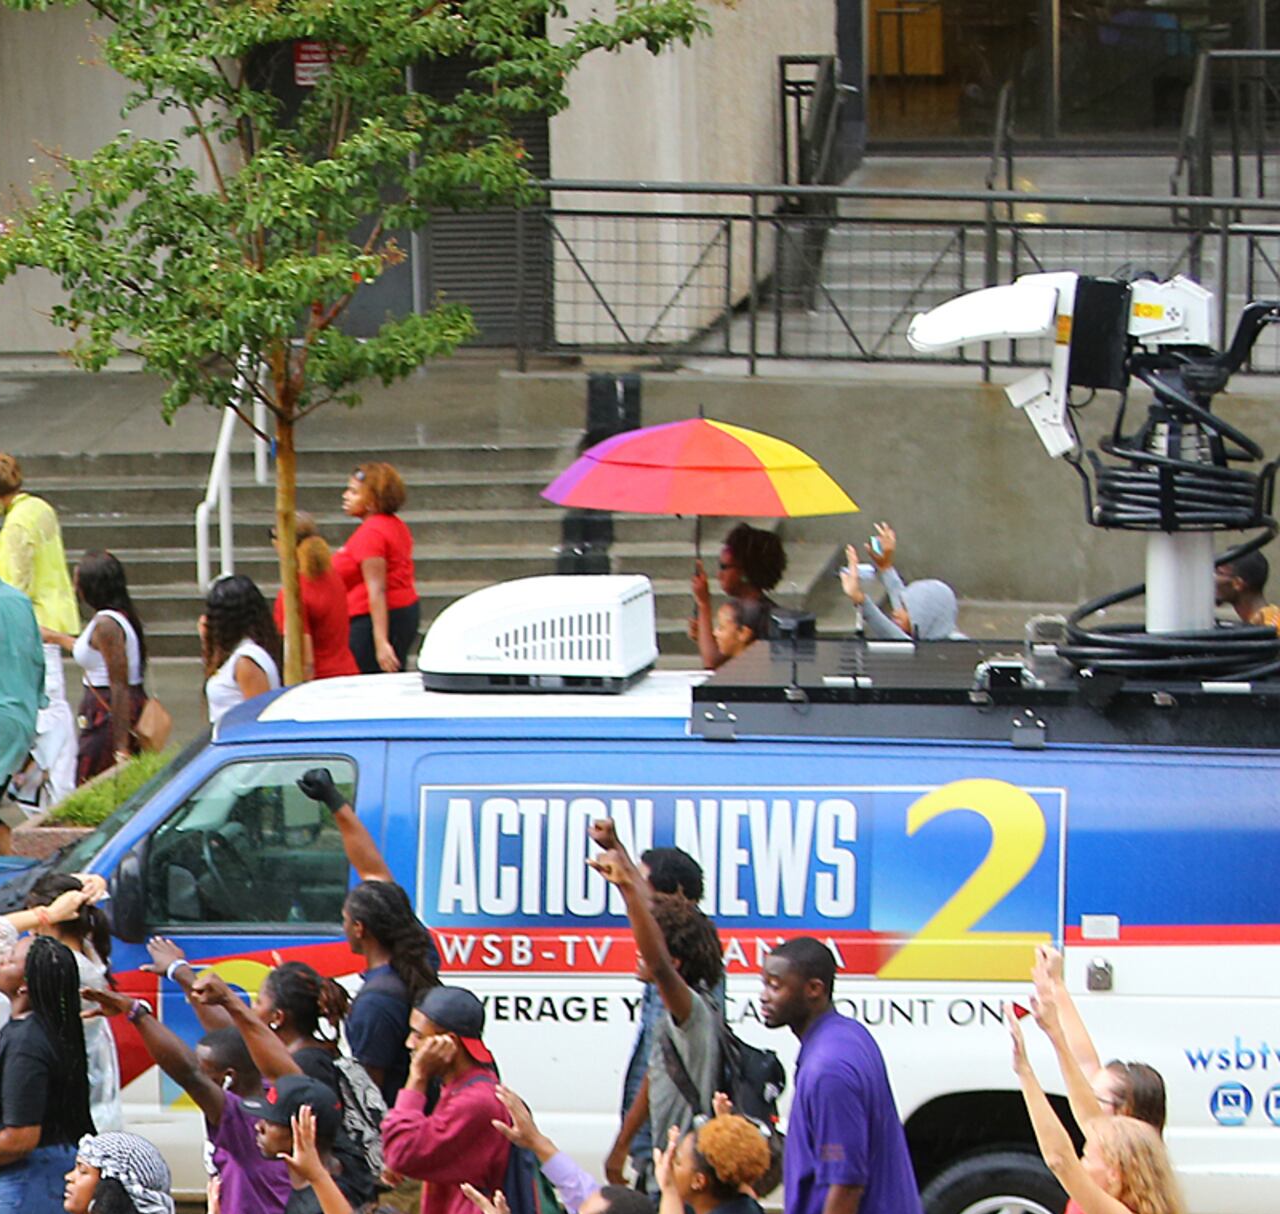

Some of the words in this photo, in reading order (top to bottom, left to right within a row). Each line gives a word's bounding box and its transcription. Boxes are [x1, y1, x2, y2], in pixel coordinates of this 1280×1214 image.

[874, 778, 1053, 980] 2
[439, 935, 613, 967] WSB-TV
[948, 1000, 1004, 1026] ON
